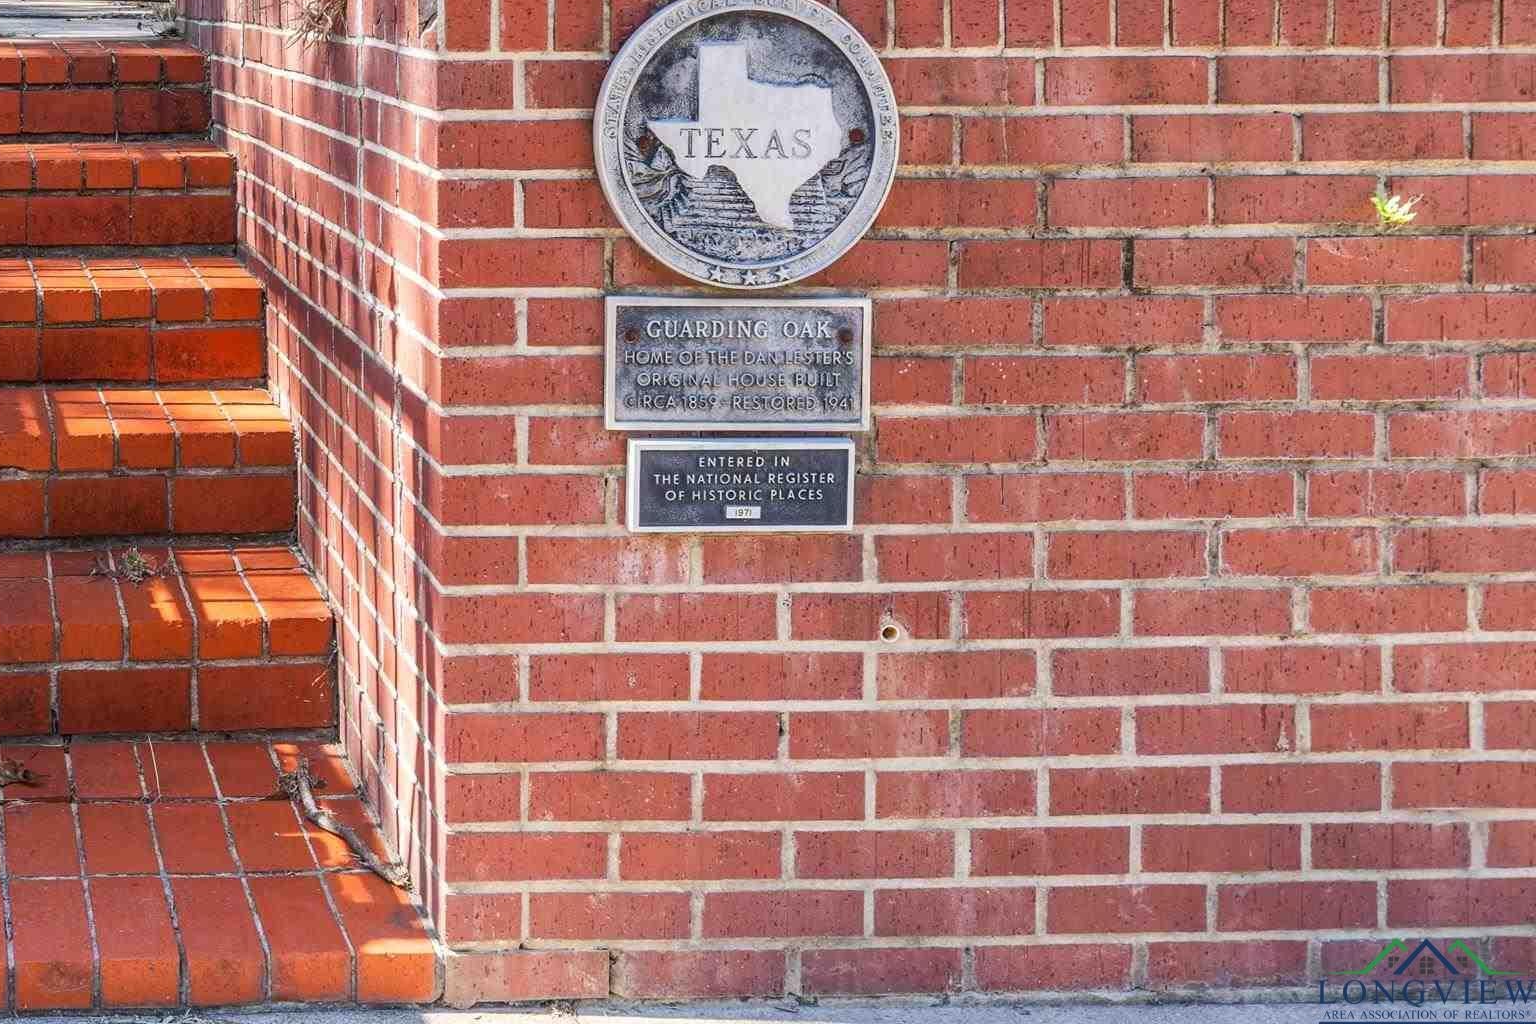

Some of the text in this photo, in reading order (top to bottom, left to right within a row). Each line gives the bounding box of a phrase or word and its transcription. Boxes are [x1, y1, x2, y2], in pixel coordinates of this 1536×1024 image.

[679, 127, 812, 160] TEXAS
[646, 320, 832, 339] GUARDING OAK
[624, 350, 855, 366] HOME OF THE DAN LESTER'S
[636, 372, 841, 388] ORIGINAL HOUSE BUILT
[624, 394, 677, 409] CIRCA
[732, 394, 816, 410] RESTORED
[823, 396, 854, 411] 1941
[698, 456, 791, 468] ENTERED IN
[653, 473, 836, 485] THE NATIONAL REGISTER
[664, 489, 824, 502] OF HISTORIC PLACES
[735, 508, 753, 517] 1971
